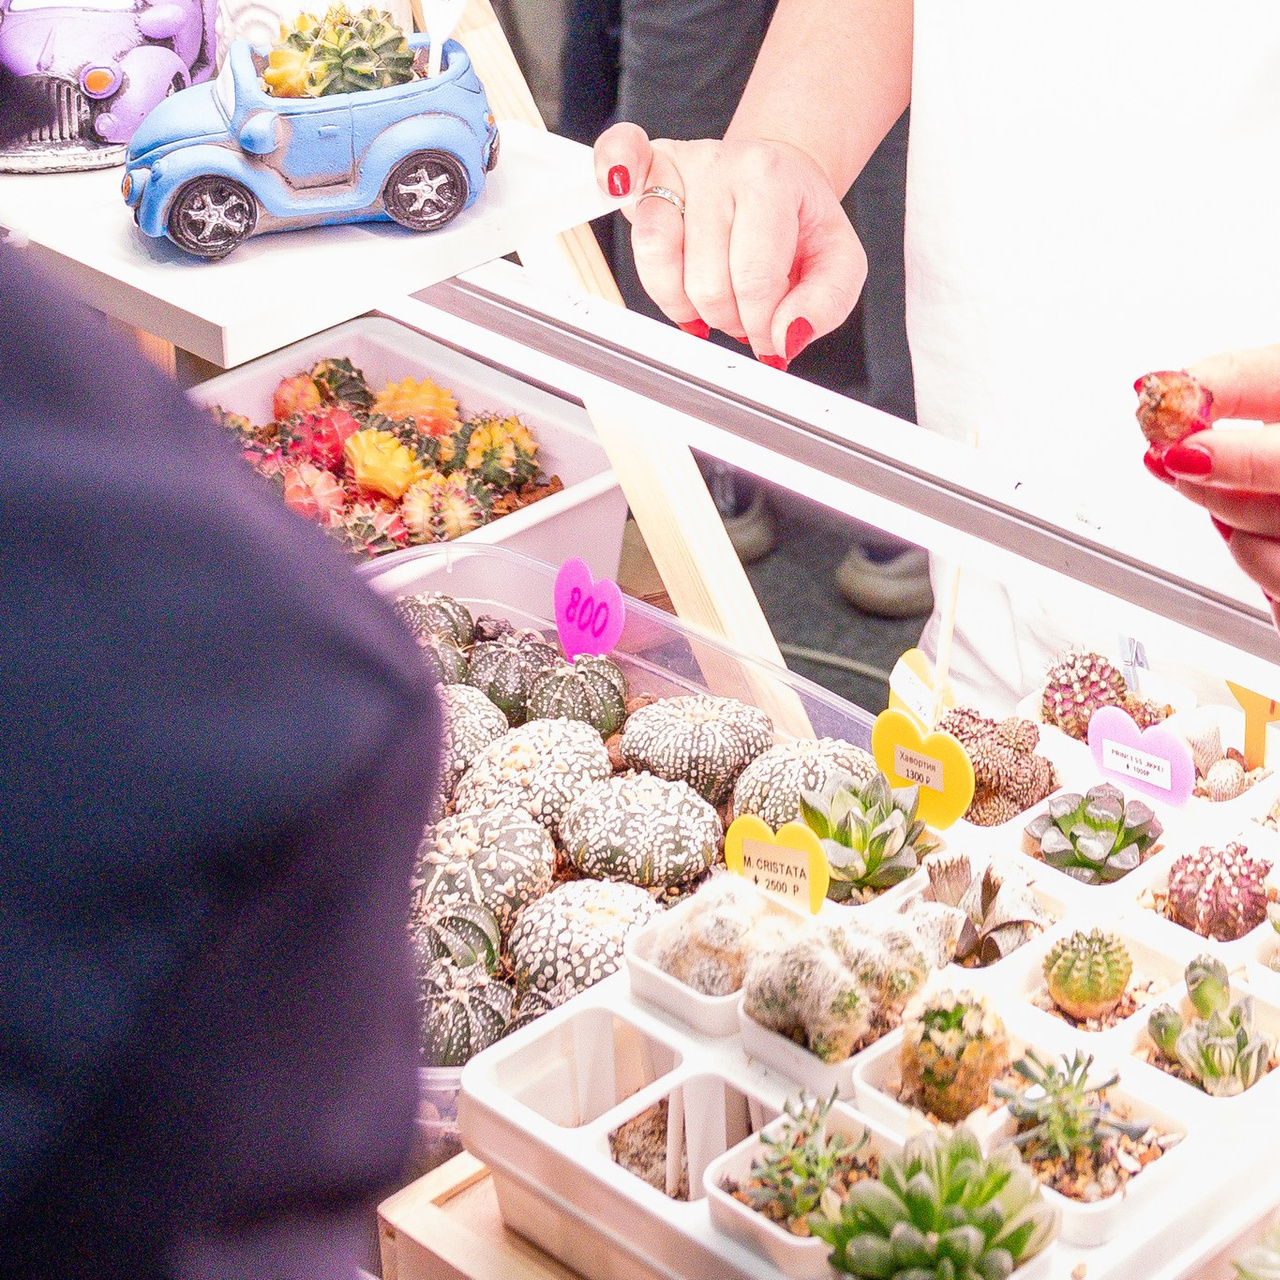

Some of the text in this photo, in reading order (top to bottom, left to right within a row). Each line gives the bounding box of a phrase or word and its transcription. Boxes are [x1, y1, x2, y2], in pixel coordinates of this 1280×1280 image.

[566, 587, 609, 638] 800
[899, 750, 937, 772] Хавортия
[905, 768, 924, 784] 1300
[743, 855, 807, 880] M. CRISTATA
[765, 878, 788, 894] 2500
